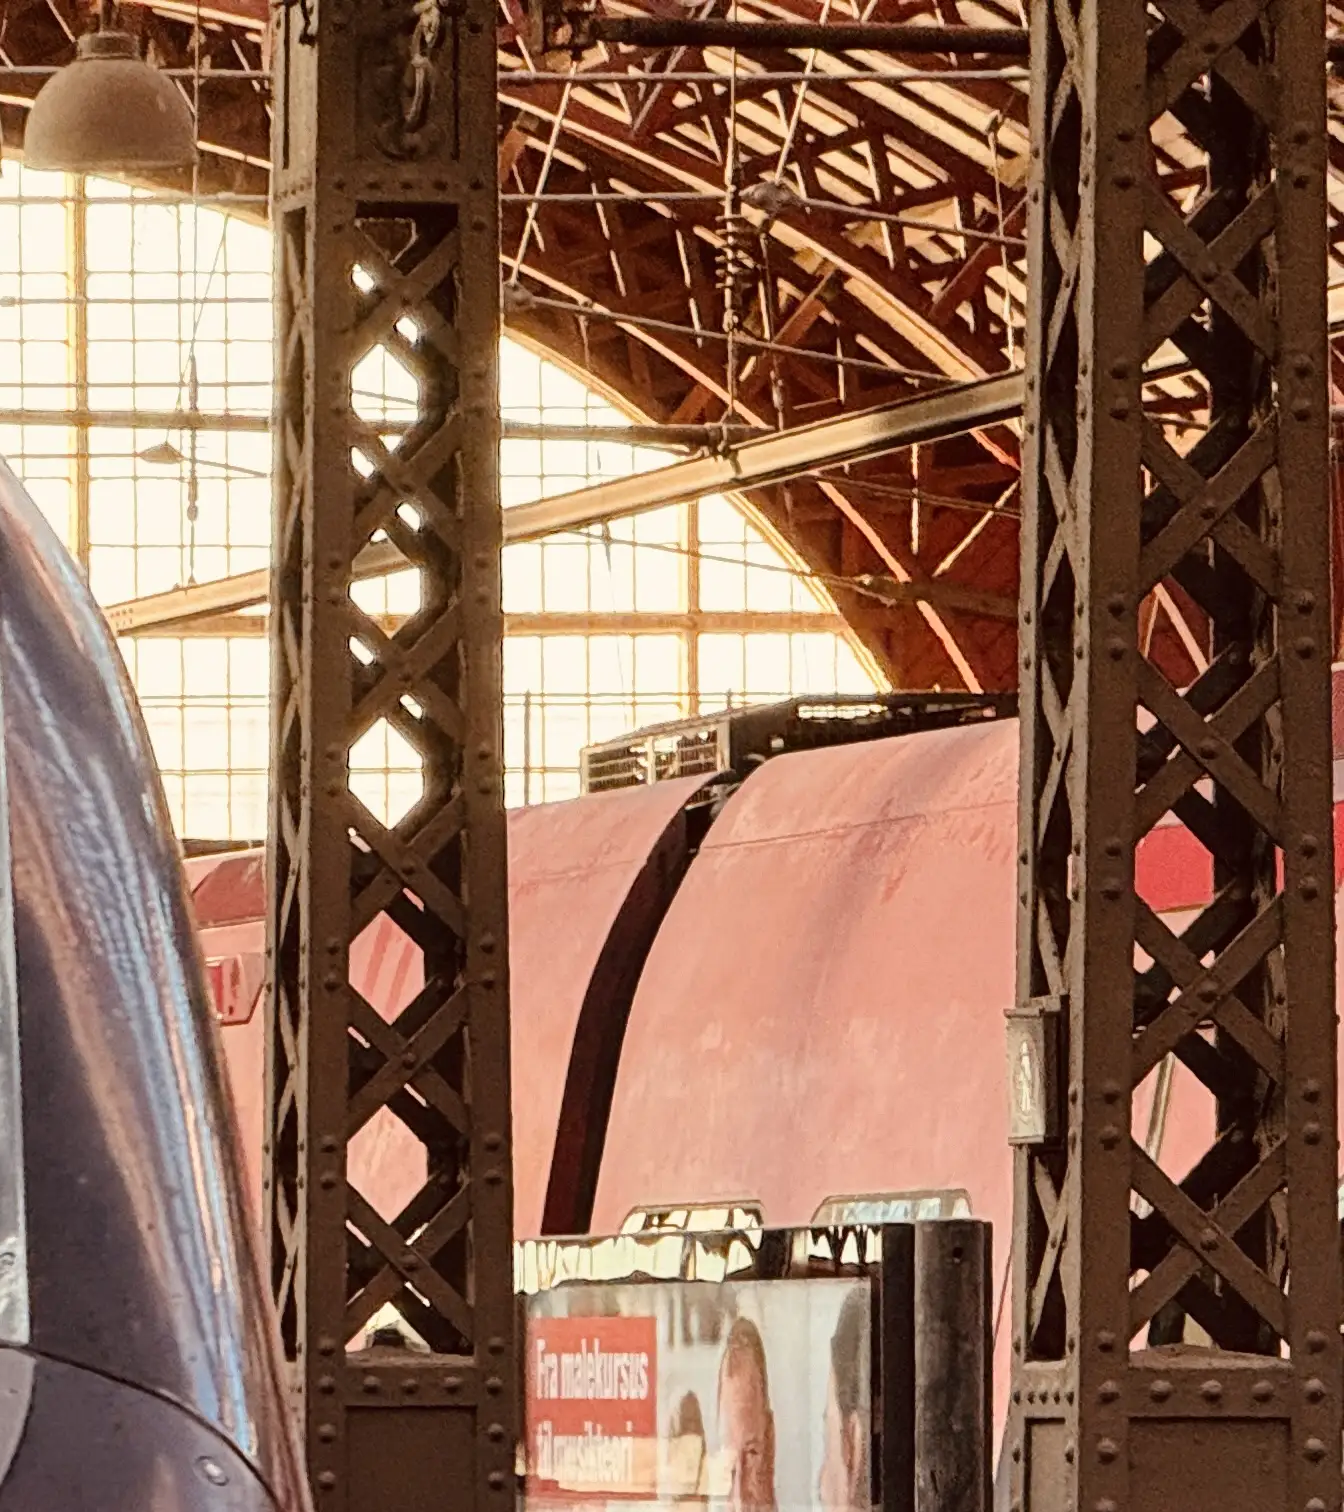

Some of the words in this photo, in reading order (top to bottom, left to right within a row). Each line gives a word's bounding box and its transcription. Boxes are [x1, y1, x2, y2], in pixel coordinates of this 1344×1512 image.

[536, 1338, 559, 1400] Fra
[560, 1337, 649, 1401] malekursus
[536, 1420, 553, 1480] til
